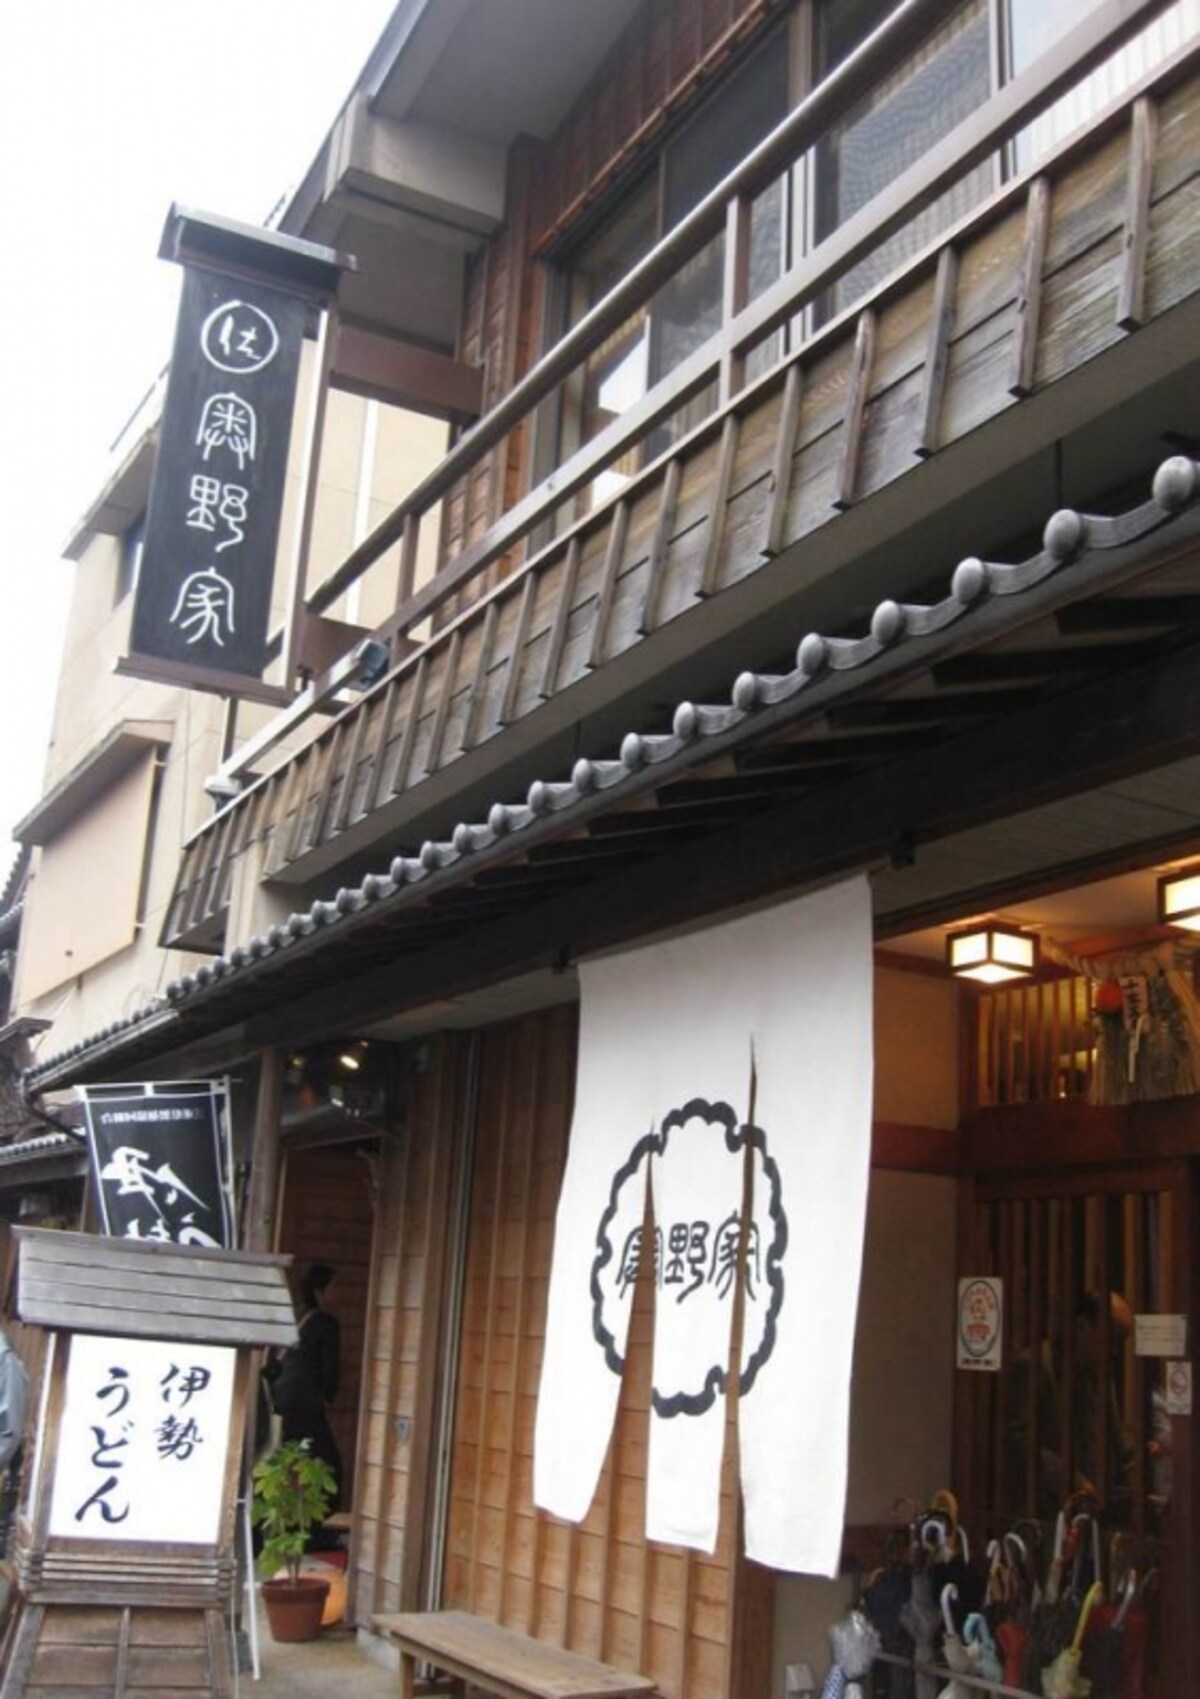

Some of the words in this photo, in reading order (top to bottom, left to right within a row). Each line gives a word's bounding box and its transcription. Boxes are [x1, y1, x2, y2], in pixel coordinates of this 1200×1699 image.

[74, 1366, 135, 1524] うどん
[154, 1363, 212, 1462] 伊勢
